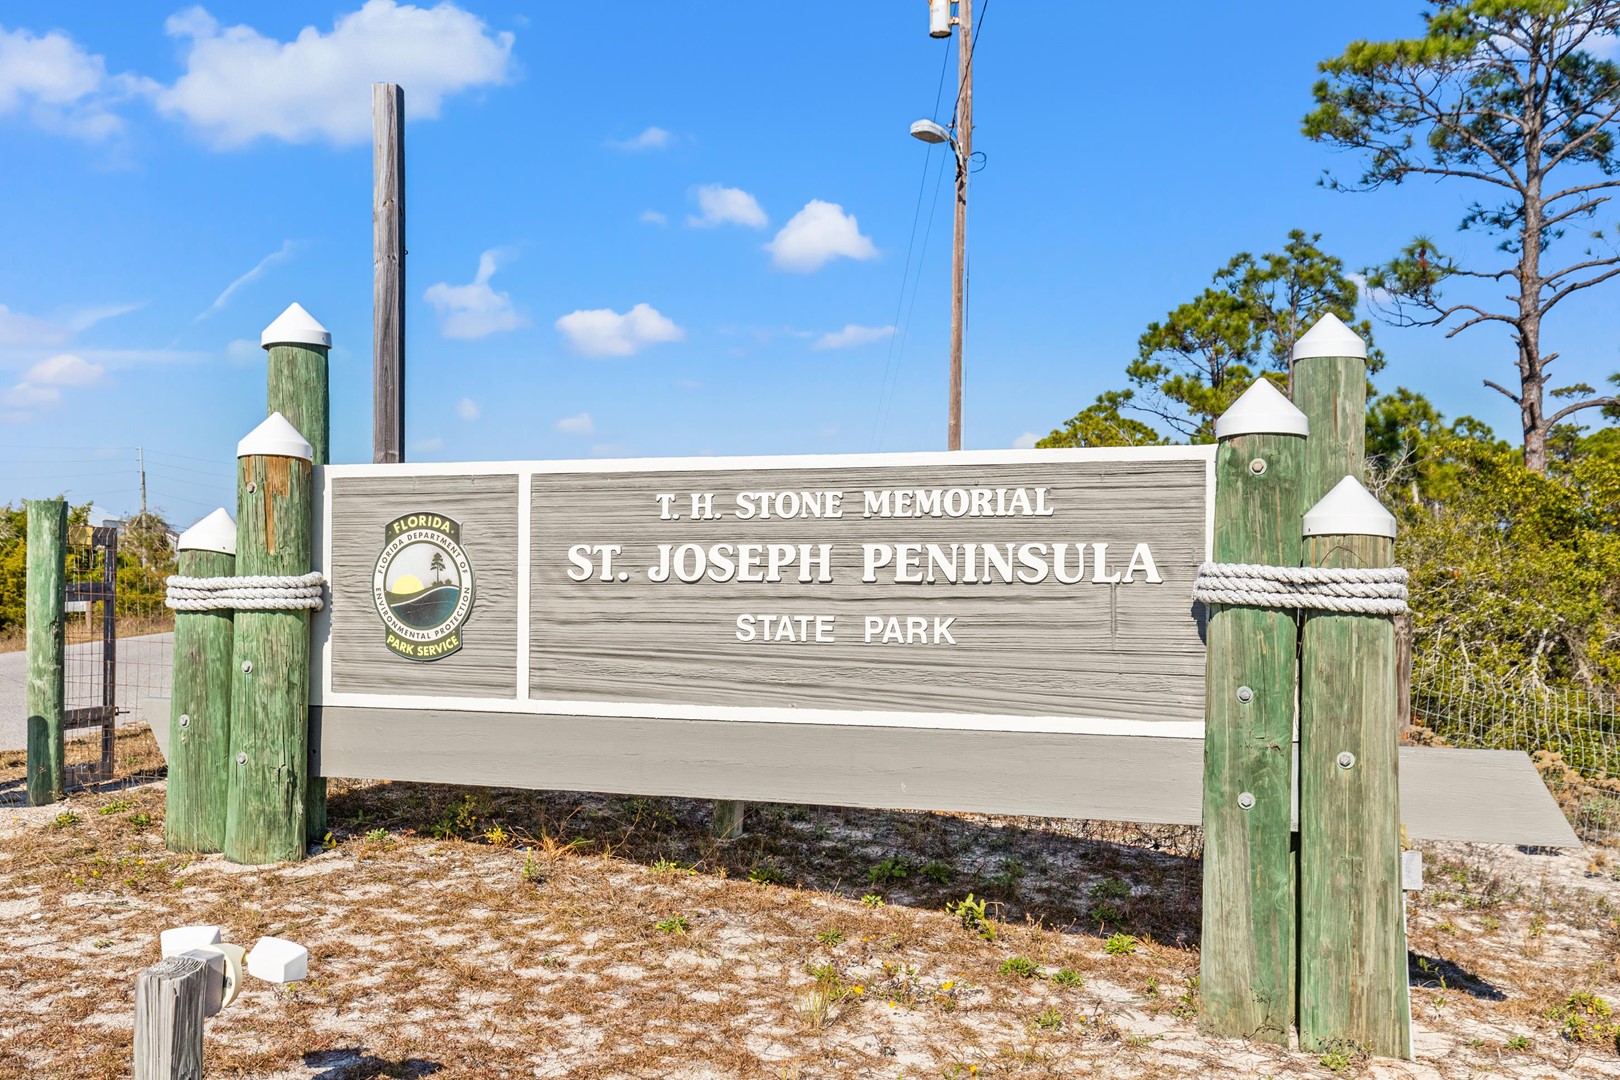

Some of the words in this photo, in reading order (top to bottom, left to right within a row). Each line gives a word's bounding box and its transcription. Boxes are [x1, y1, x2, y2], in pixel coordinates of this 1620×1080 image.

[654, 493, 679, 519] T.
[690, 493, 721, 519] H.
[735, 491, 843, 519] STONE
[862, 487, 1055, 518] MEMORIAL
[393, 515, 450, 534] FLORIDA
[378, 539, 404, 575] FLORIDA
[407, 531, 461, 558] DEPARTMENT
[459, 561, 469, 574] OF
[566, 543, 629, 582] ST.
[648, 543, 833, 583] JOSEPH
[861, 541, 1163, 584] PENINSULA
[376, 587, 431, 640] ENVIRONMENTAL
[434, 587, 470, 637] PROTECTION
[735, 613, 836, 643] STATE
[863, 615, 957, 645] PARK
[386, 634, 414, 655] PARK
[417, 635, 459, 657] SERVICE
